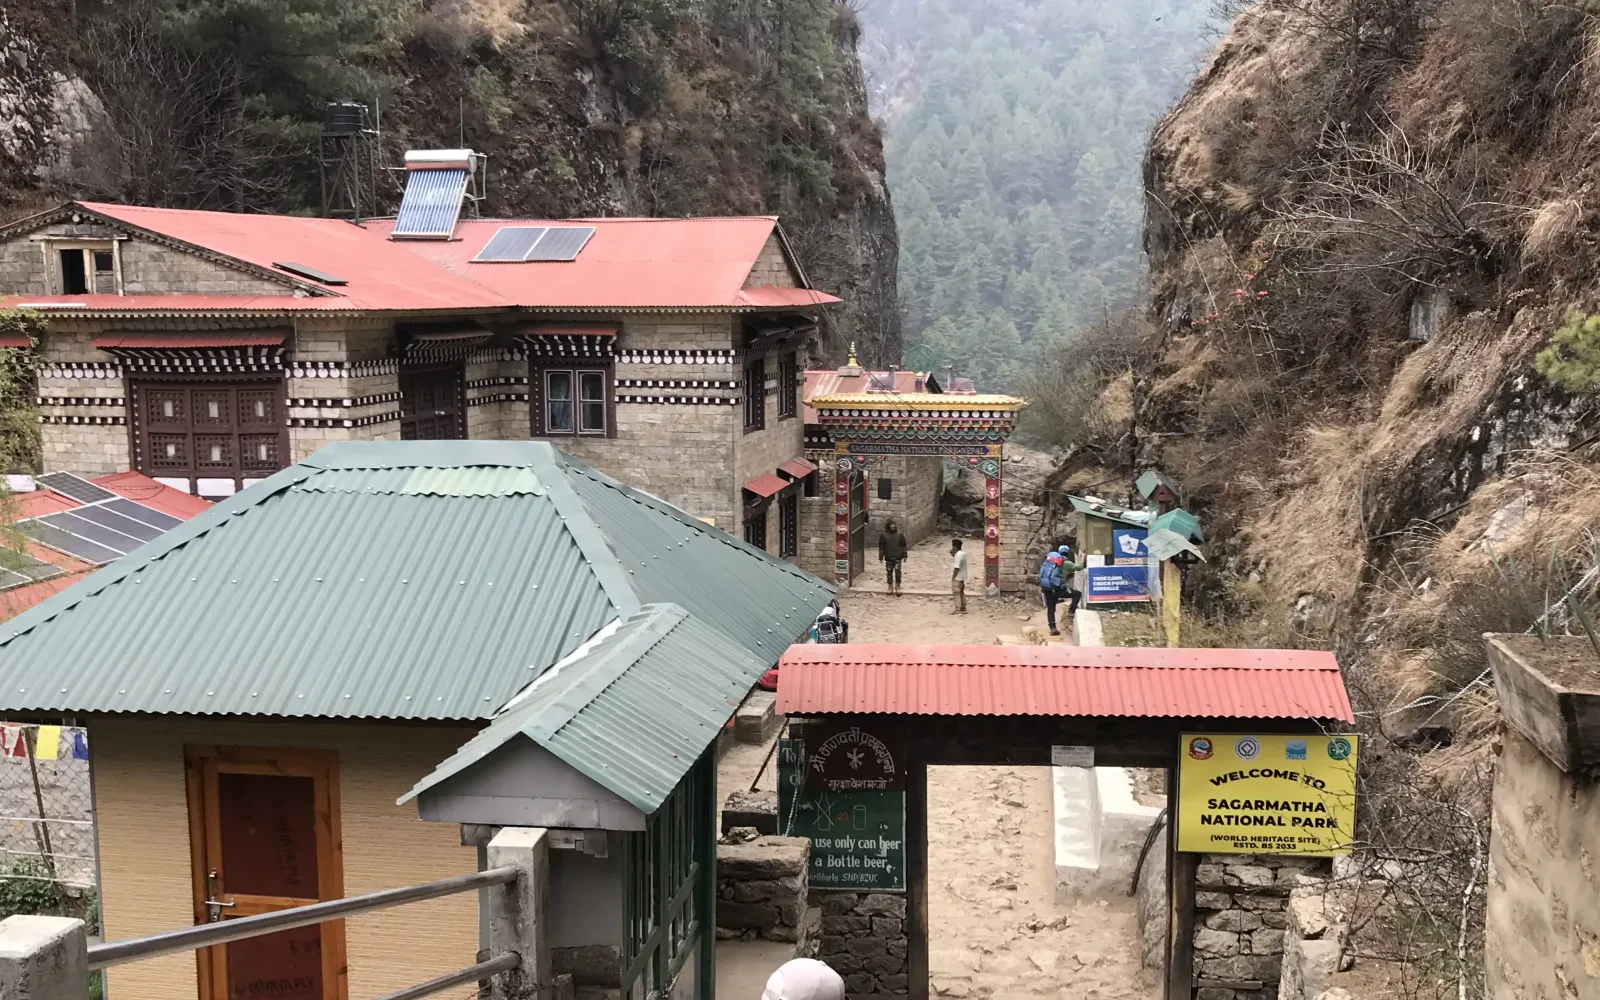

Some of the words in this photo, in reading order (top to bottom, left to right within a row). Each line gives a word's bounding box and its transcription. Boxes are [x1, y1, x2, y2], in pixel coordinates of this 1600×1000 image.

[850, 444, 900, 453] SAGARMATHA
[900, 445, 938, 454] NATIONAL
[1209, 768, 1300, 787] WELCOME
[1303, 774, 1326, 790] TO
[1207, 798, 1326, 813] SAGARMATHA
[1200, 814, 1286, 827] NATIONAL
[1291, 816, 1338, 829] PARK
[815, 837, 832, 848] use
[834, 834, 856, 853] only
[857, 838, 877, 849] can
[879, 835, 901, 850] beer
[1210, 834, 1248, 842] (WORLD
[1250, 835, 1296, 843] HERITAGE
[1297, 836, 1321, 845] SITE)
[1261, 842, 1274, 850] BS
[1275, 842, 1297, 850] 2033
[814, 857, 823, 867] a
[827, 854, 861, 868] Bottle
